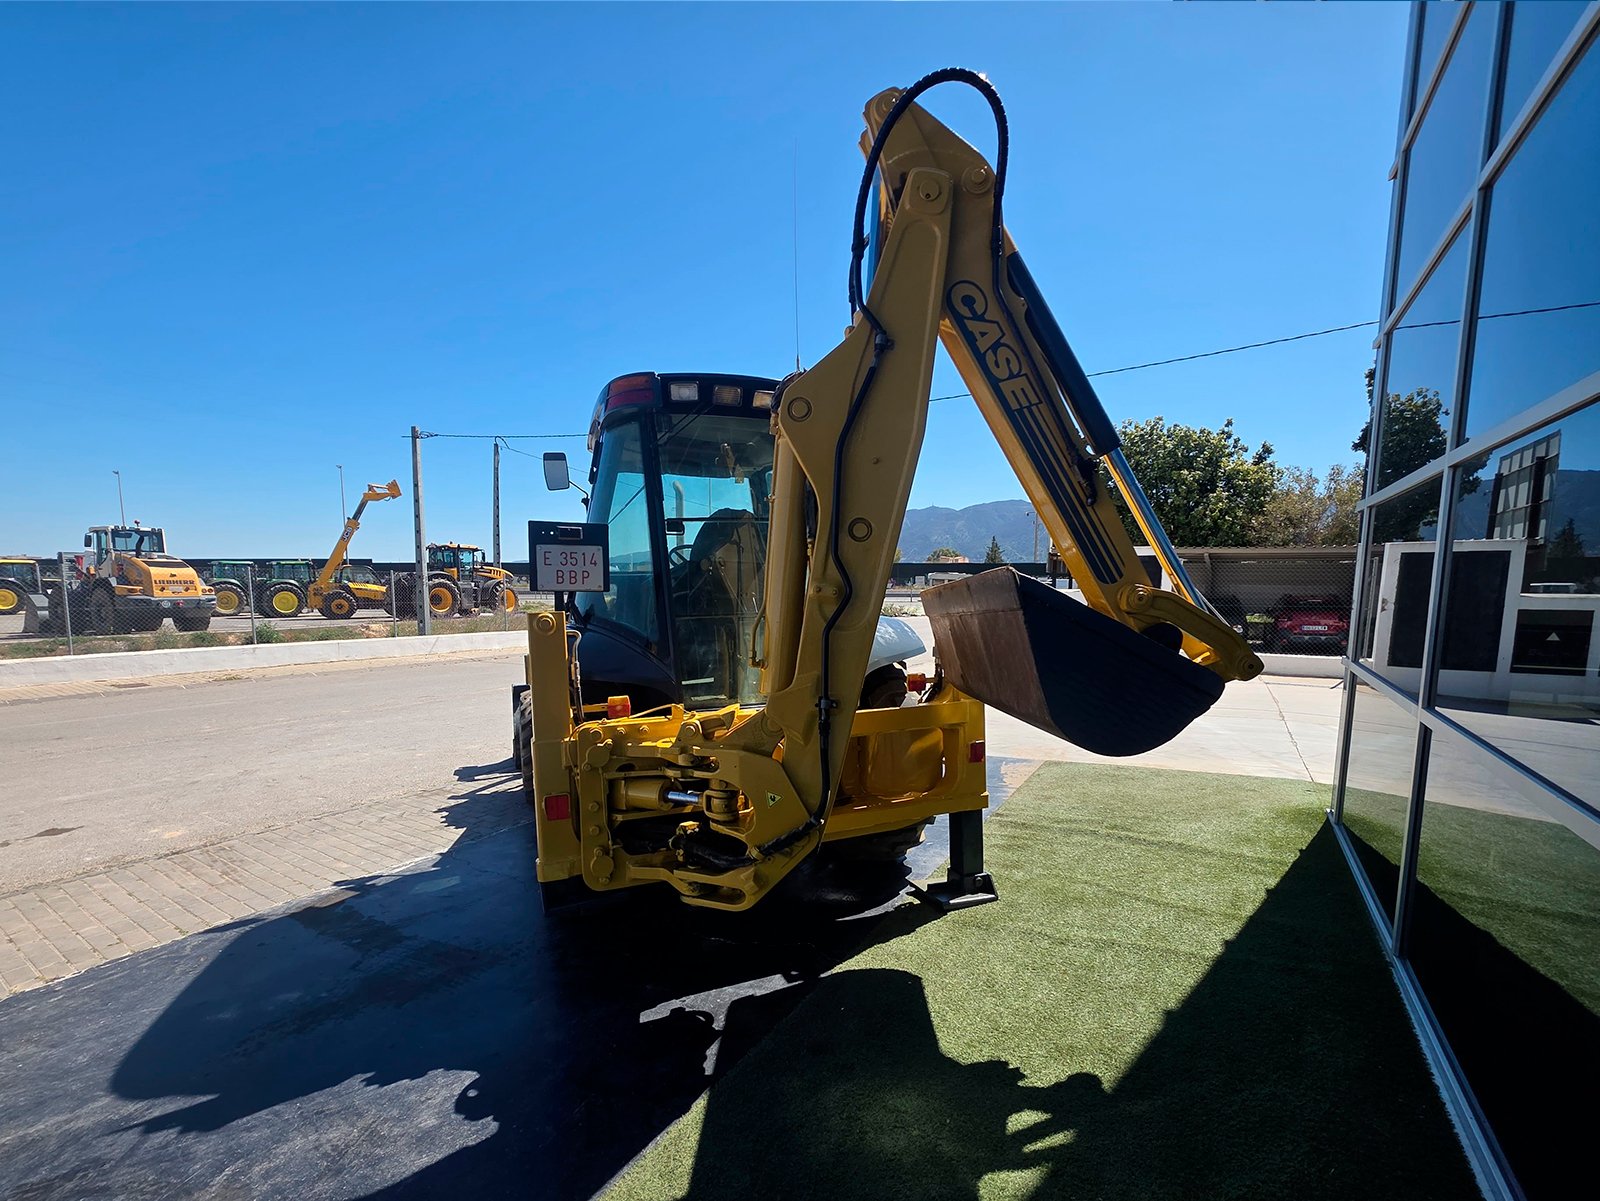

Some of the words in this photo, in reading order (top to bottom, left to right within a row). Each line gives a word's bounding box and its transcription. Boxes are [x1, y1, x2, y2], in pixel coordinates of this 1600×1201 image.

[946, 279, 1043, 411] CASE
[342, 526, 353, 541] JCB
[543, 551, 552, 566] E
[559, 551, 598, 567] 3514
[556, 569, 590, 585] BBP
